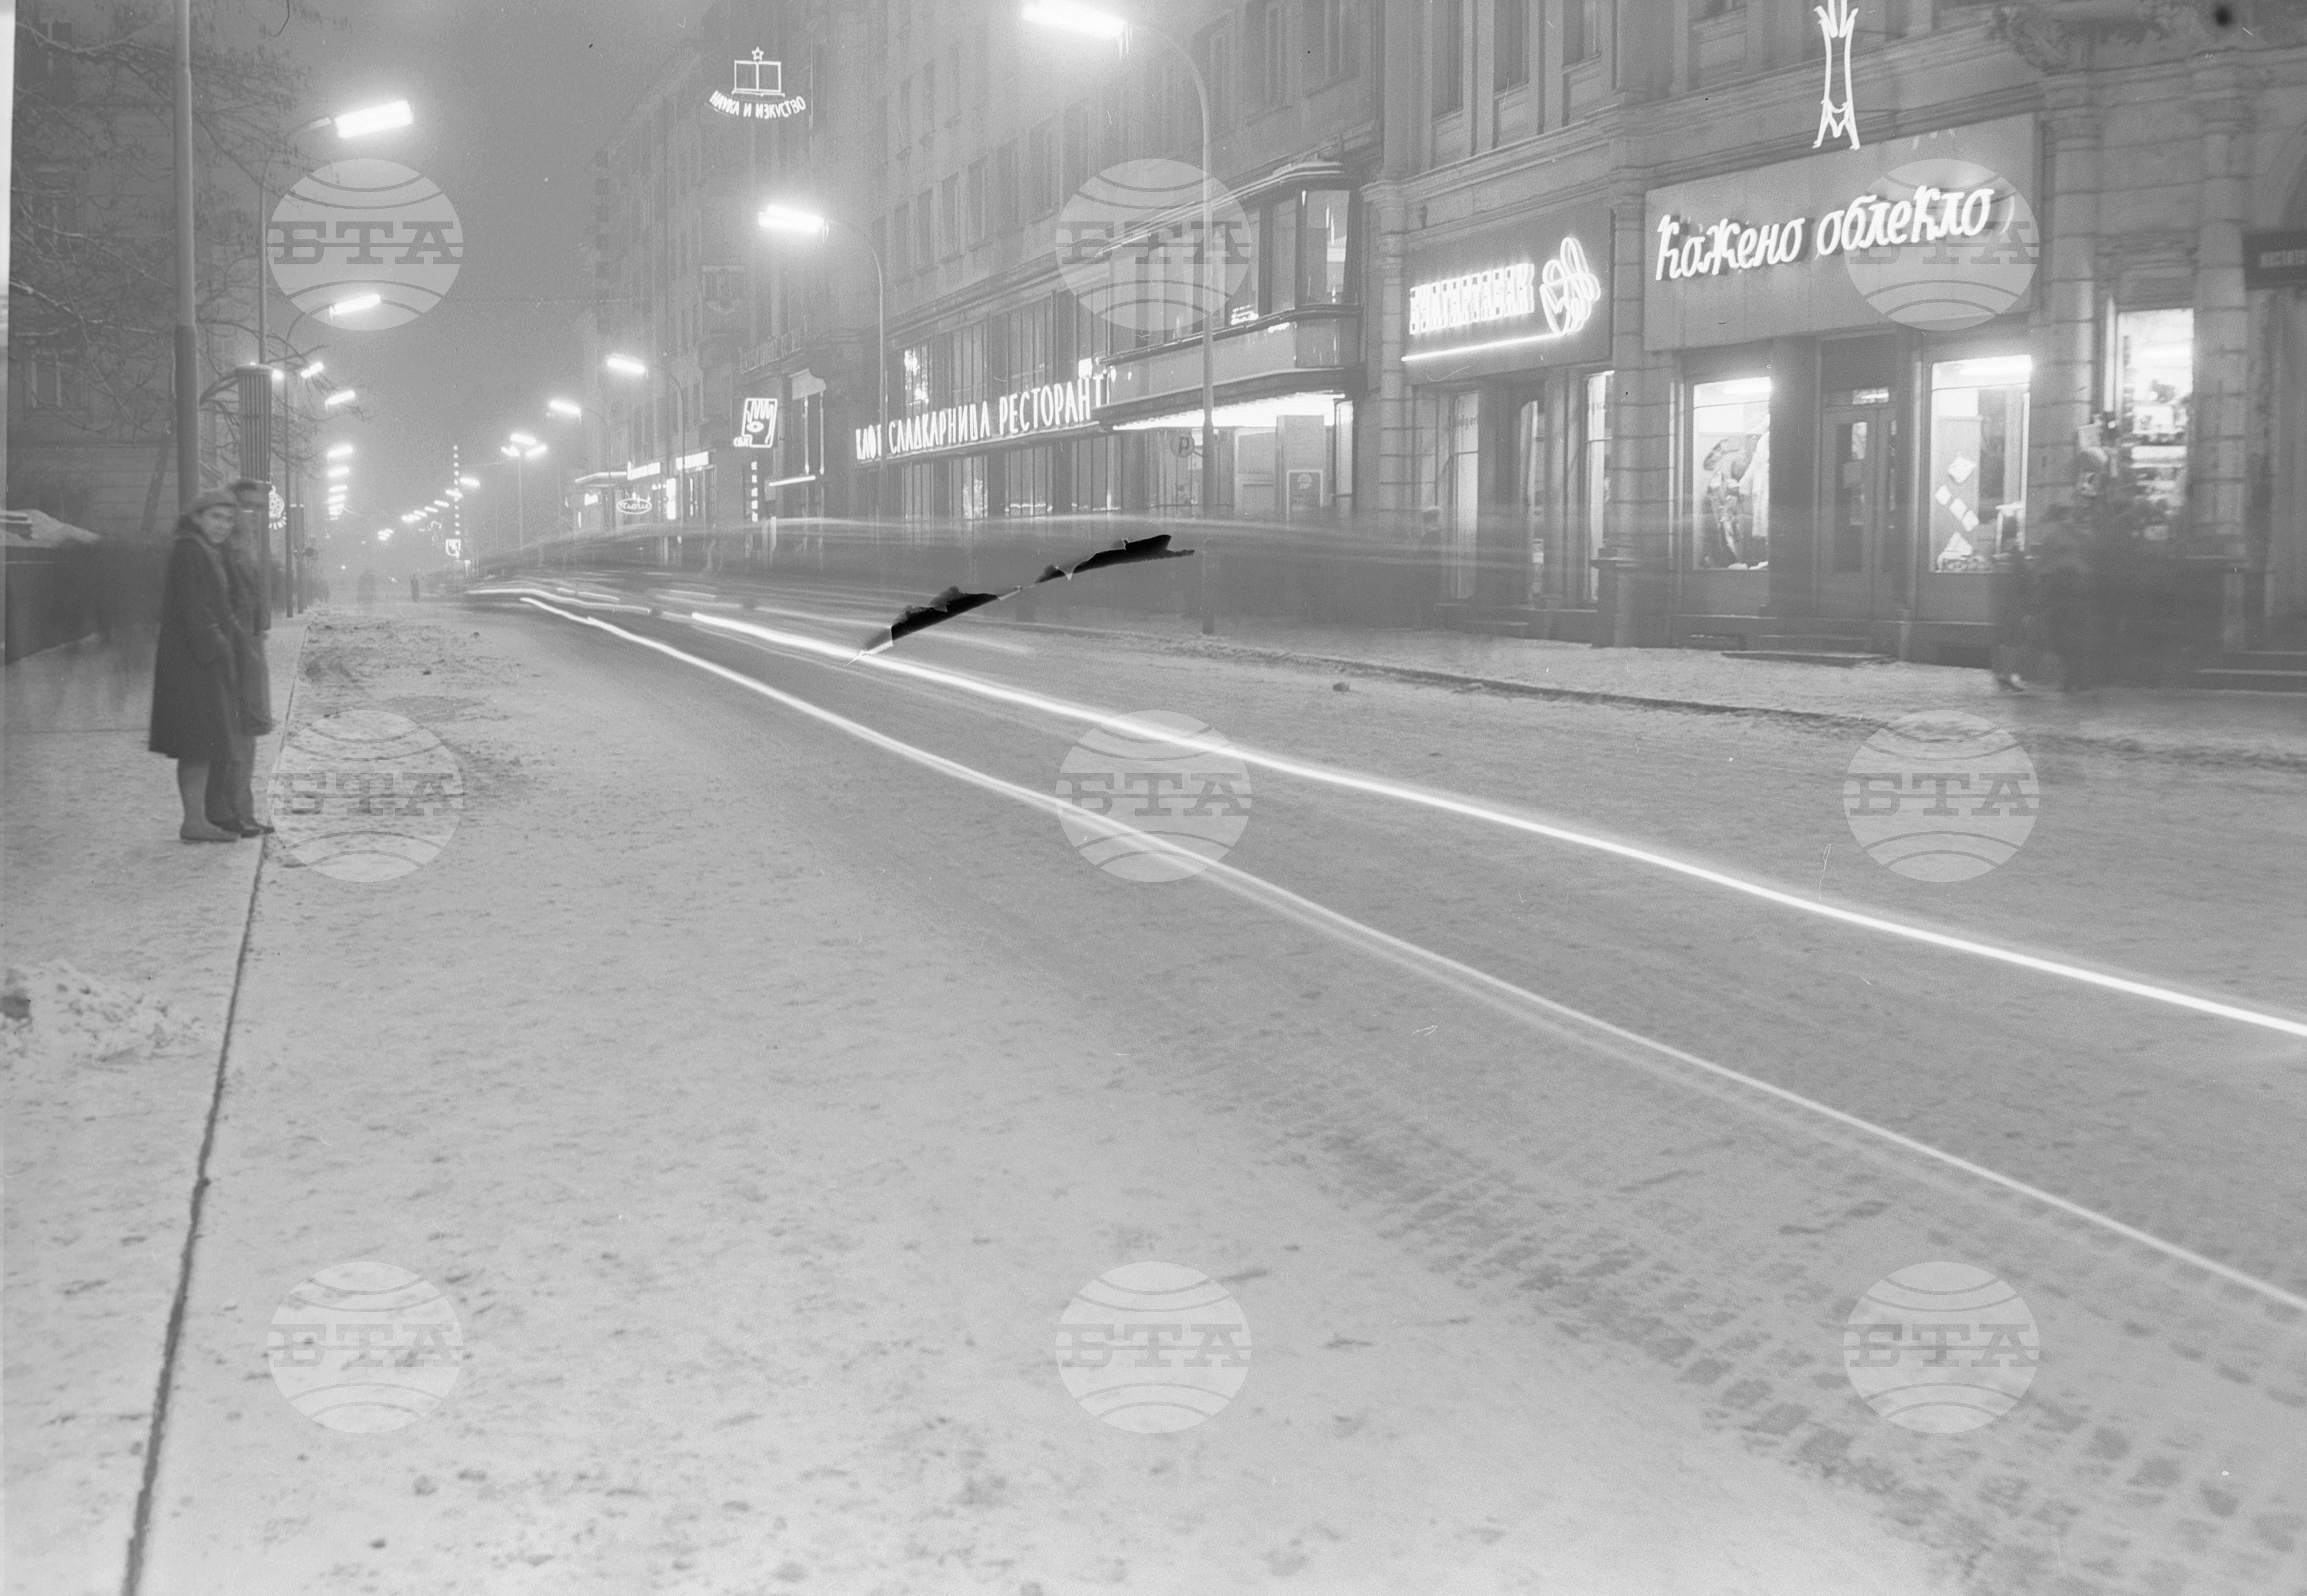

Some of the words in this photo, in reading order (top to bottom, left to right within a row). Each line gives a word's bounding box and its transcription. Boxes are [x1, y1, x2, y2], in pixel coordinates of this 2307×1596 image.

[709, 91, 739, 115] НАУКА
[743, 103, 752, 117] И
[888, 401, 990, 454] СЛАДКАРНИЦА
[999, 374, 1104, 435] РЕСТОРАНТ
